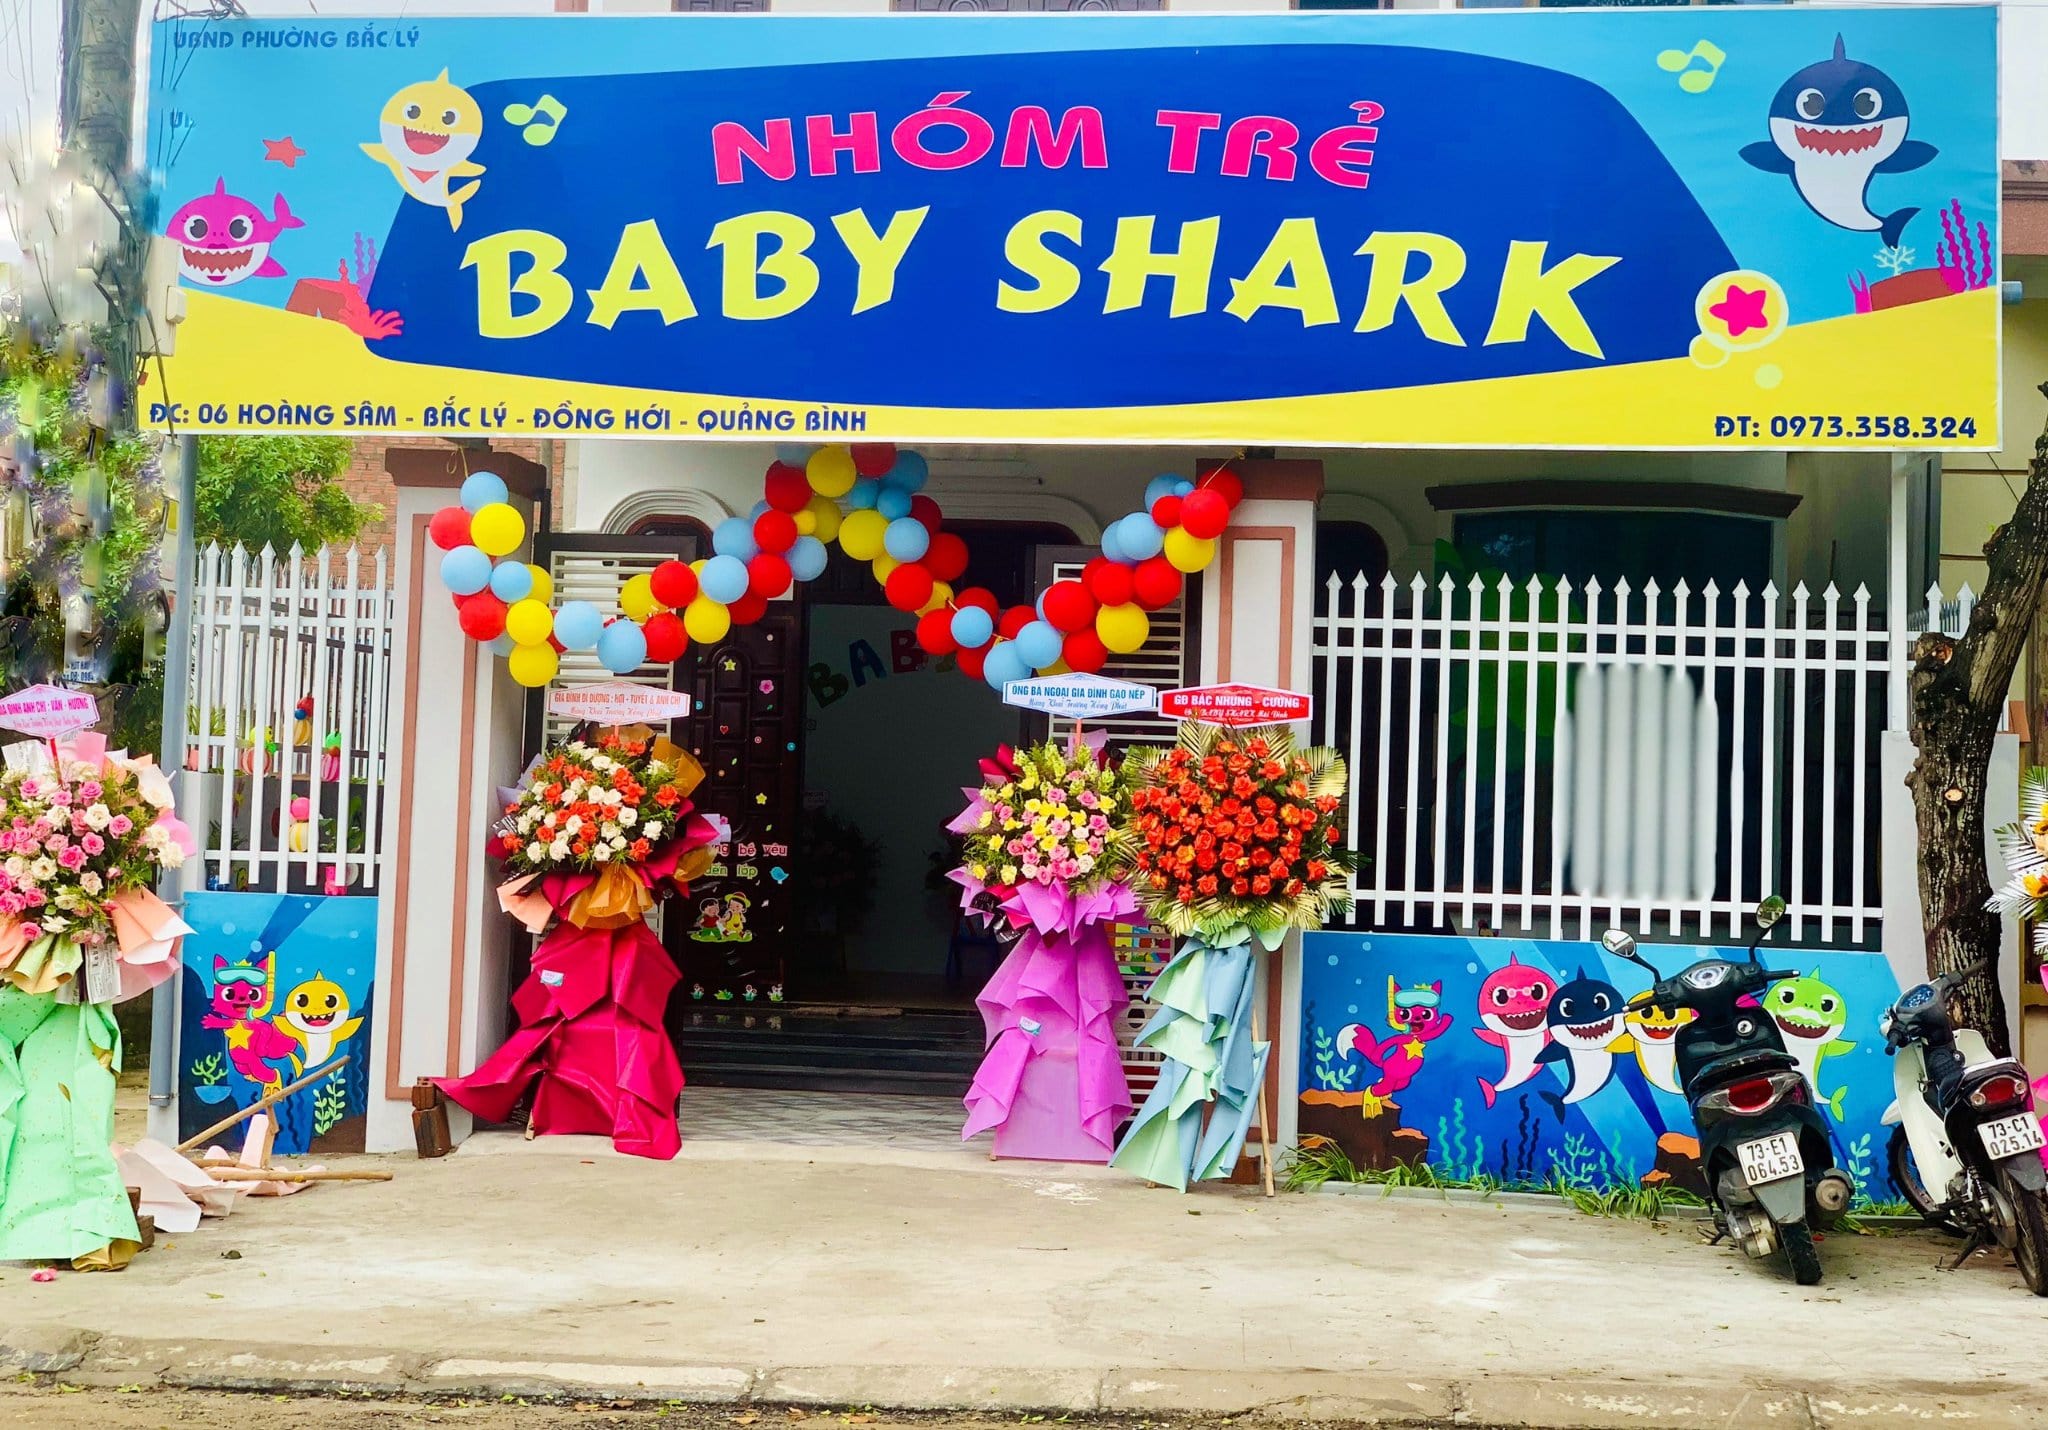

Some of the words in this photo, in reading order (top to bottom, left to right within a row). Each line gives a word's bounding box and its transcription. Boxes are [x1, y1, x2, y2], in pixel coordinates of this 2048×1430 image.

[173, 31, 234, 48] UBND
[242, 27, 338, 48] PHƯỜNG
[346, 23, 387, 48] BẮC
[395, 26, 420, 48] LÝ
[711, 90, 1109, 185] NHÓM
[1156, 99, 1386, 190] TRẺ
[458, 204, 932, 340] BABY
[995, 208, 1625, 361] SHARK
[149, 403, 189, 424] ĐC:
[198, 403, 228, 424] 06
[238, 398, 335, 425] HOÀNG
[343, 400, 397, 426] SÂM
[423, 395, 471, 428] BẮC
[481, 401, 508, 428] LÝ
[533, 400, 616, 430] ĐỒNG
[625, 403, 671, 430] HỚI
[697, 402, 796, 432] QUẢNG
[805, 405, 867, 432] BÌNH
[1714, 415, 1761, 437] ĐT:
[1770, 415, 1978, 438] 0973.358.324
[808, 629, 957, 708] BAB
[1072, 688, 1085, 698] GIA
[1191, 693, 1212, 707] BÁC
[1215, 696, 1252, 707] NHUNG
[1988, 1116, 2030, 1139] 73-C1
[1746, 1137, 1788, 1161] 73-E1
[1989, 1130, 2043, 1156] 025.14
[1747, 1154, 1800, 1182] 064.53
